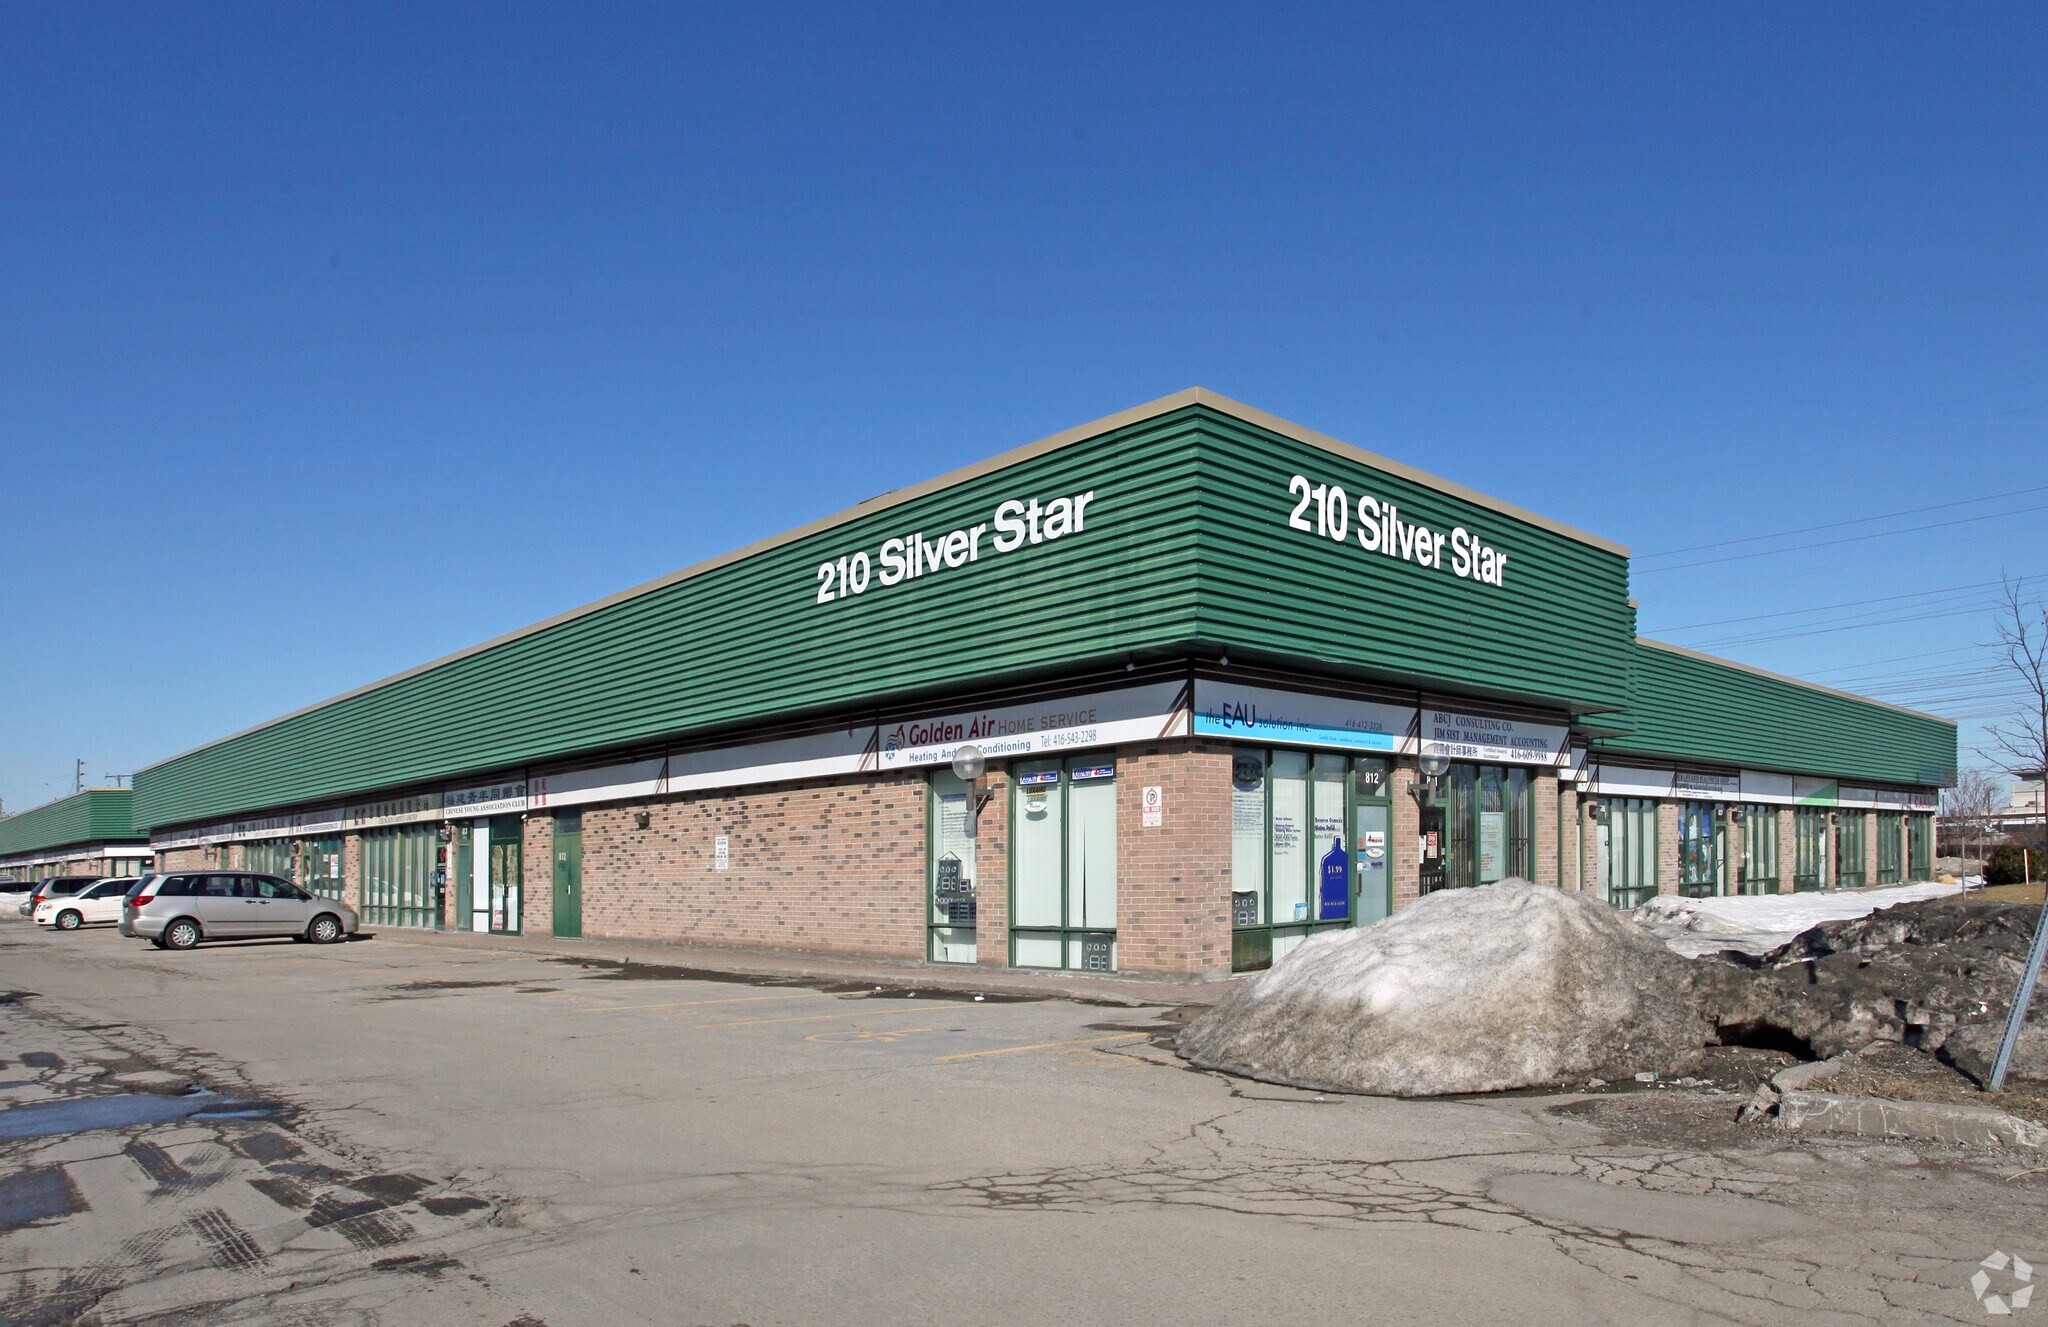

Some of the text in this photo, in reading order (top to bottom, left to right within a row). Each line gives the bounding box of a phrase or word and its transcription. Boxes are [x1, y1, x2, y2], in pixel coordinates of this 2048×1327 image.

[1288, 474, 1508, 588] 210 Silver Star
[816, 490, 1095, 605] 210 Silver Star
[1204, 701, 1312, 733] the EAU solution inc.
[1433, 713, 1514, 732] ABCJ CONSULTING CO.
[909, 709, 1097, 746] Golden Air HOME SERVICE
[1040, 729, 1097, 748] Tel: 416-543-2298
[1463, 731, 1508, 746] MANAGEMENT
[1510, 737, 1548, 749] ACCOUNTING
[909, 747, 938, 763] Heating
[940, 746, 957, 760] And
[976, 739, 1031, 756] Conditioning
[1510, 748, 1548, 762] 416-609-9988
[1364, 771, 1379, 785] 812
[445, 784, 526, 806] 福建青年同鄉會
[445, 799, 526, 815] CHINESE YOUNG ASSOCIATION CLUB
